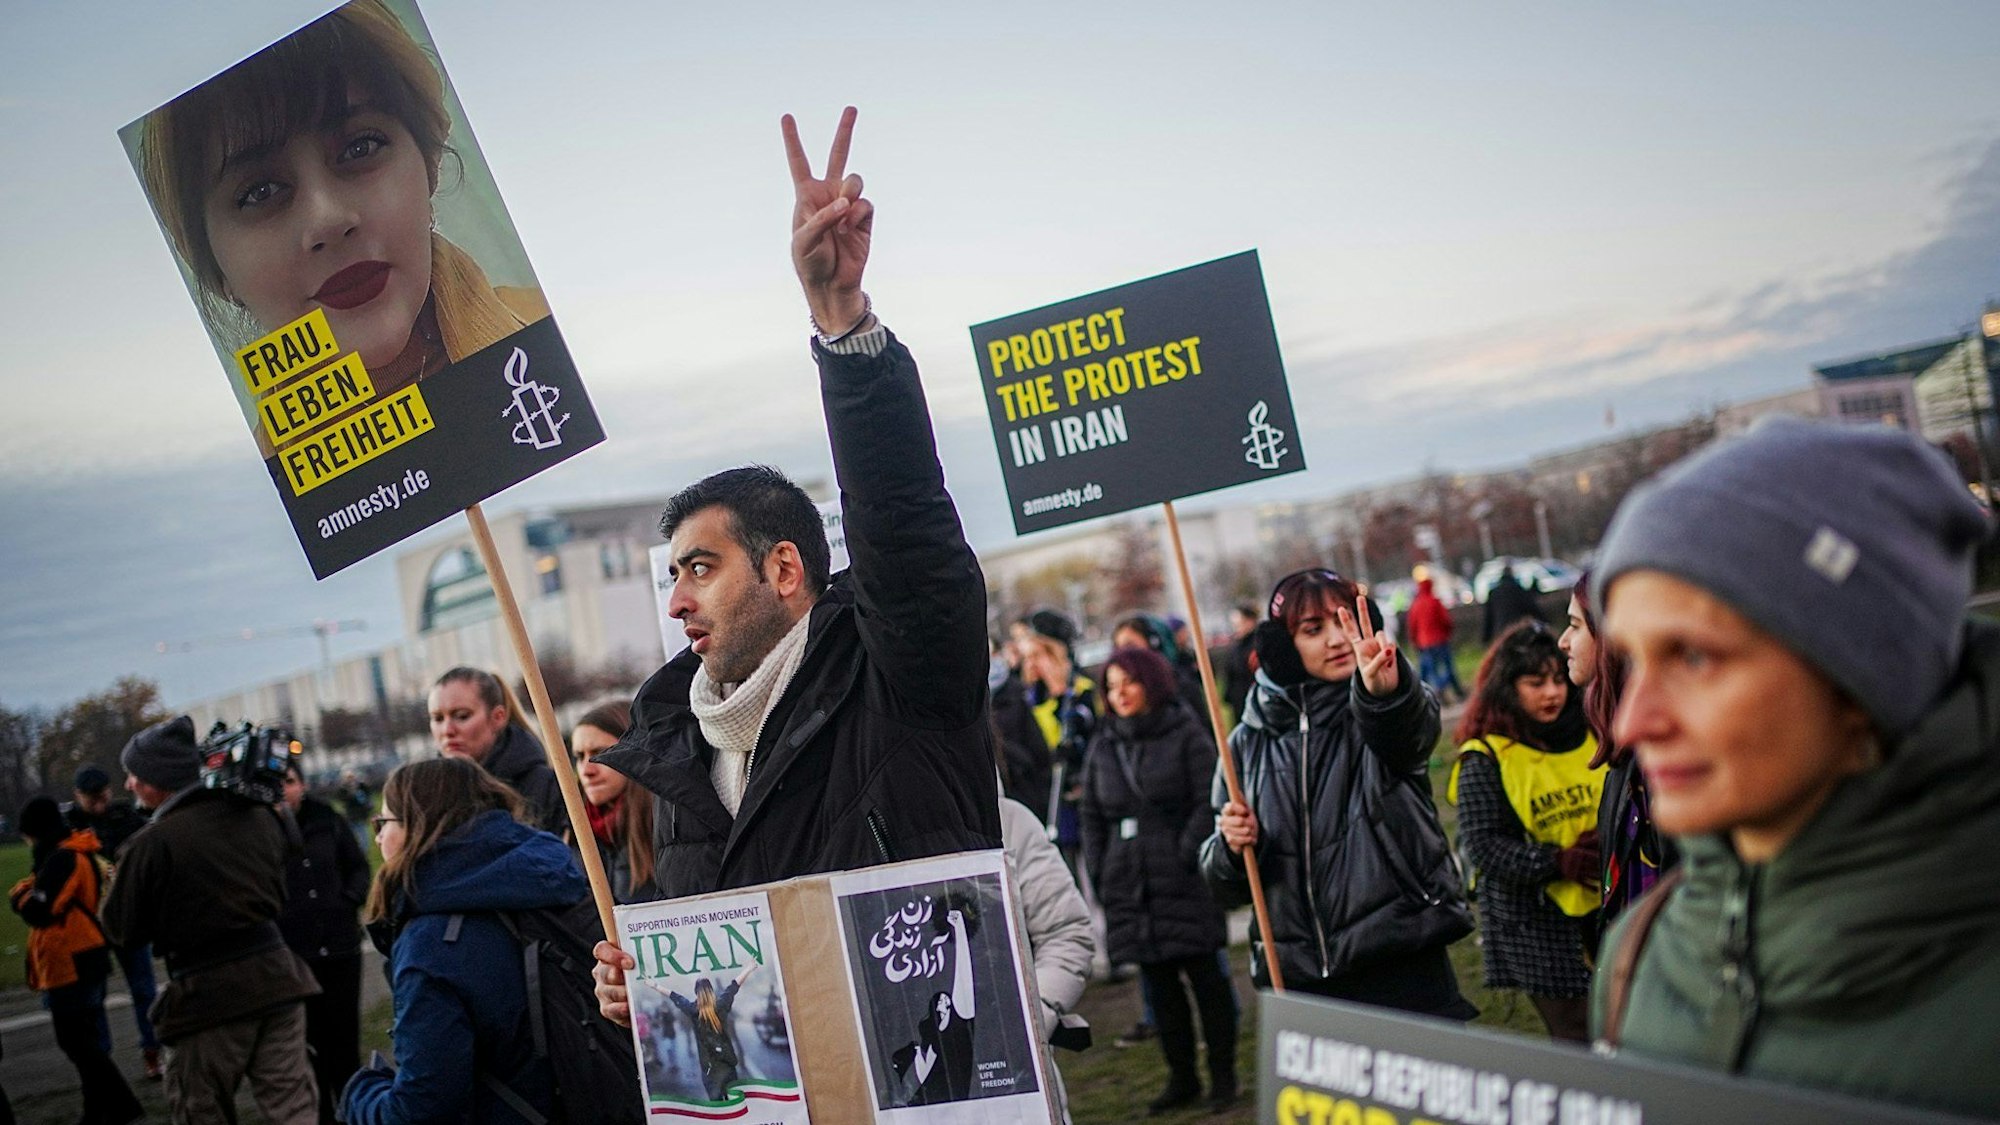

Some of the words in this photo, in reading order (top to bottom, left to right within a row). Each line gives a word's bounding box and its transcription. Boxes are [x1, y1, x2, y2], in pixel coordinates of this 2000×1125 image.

[243, 325, 332, 388] FRAU.
[987, 307, 1125, 378] PROTECT
[264, 364, 369, 438] LEBEN.
[996, 375, 1059, 422] THE
[1063, 336, 1202, 406] PROTEST
[286, 395, 429, 487] FREIHEIT.
[1008, 425, 1046, 467] IN
[1050, 405, 1129, 457] IRAN
[317, 466, 430, 540] amnesty.de
[1022, 482, 1103, 516] amnesty.de
[627, 917, 680, 933] SUPPORTING
[681, 913, 707, 927] IRANS
[709, 906, 759, 922] MOVEMENT
[869, 911, 921, 959] زندگی
[901, 895, 933, 925] زن
[630, 919, 764, 980] IRAN
[885, 932, 950, 983] آزادی
[977, 1061, 1007, 1071] WOMEN
[980, 1071, 994, 1080] LIFE
[981, 1077, 1016, 1088] FREEDOM
